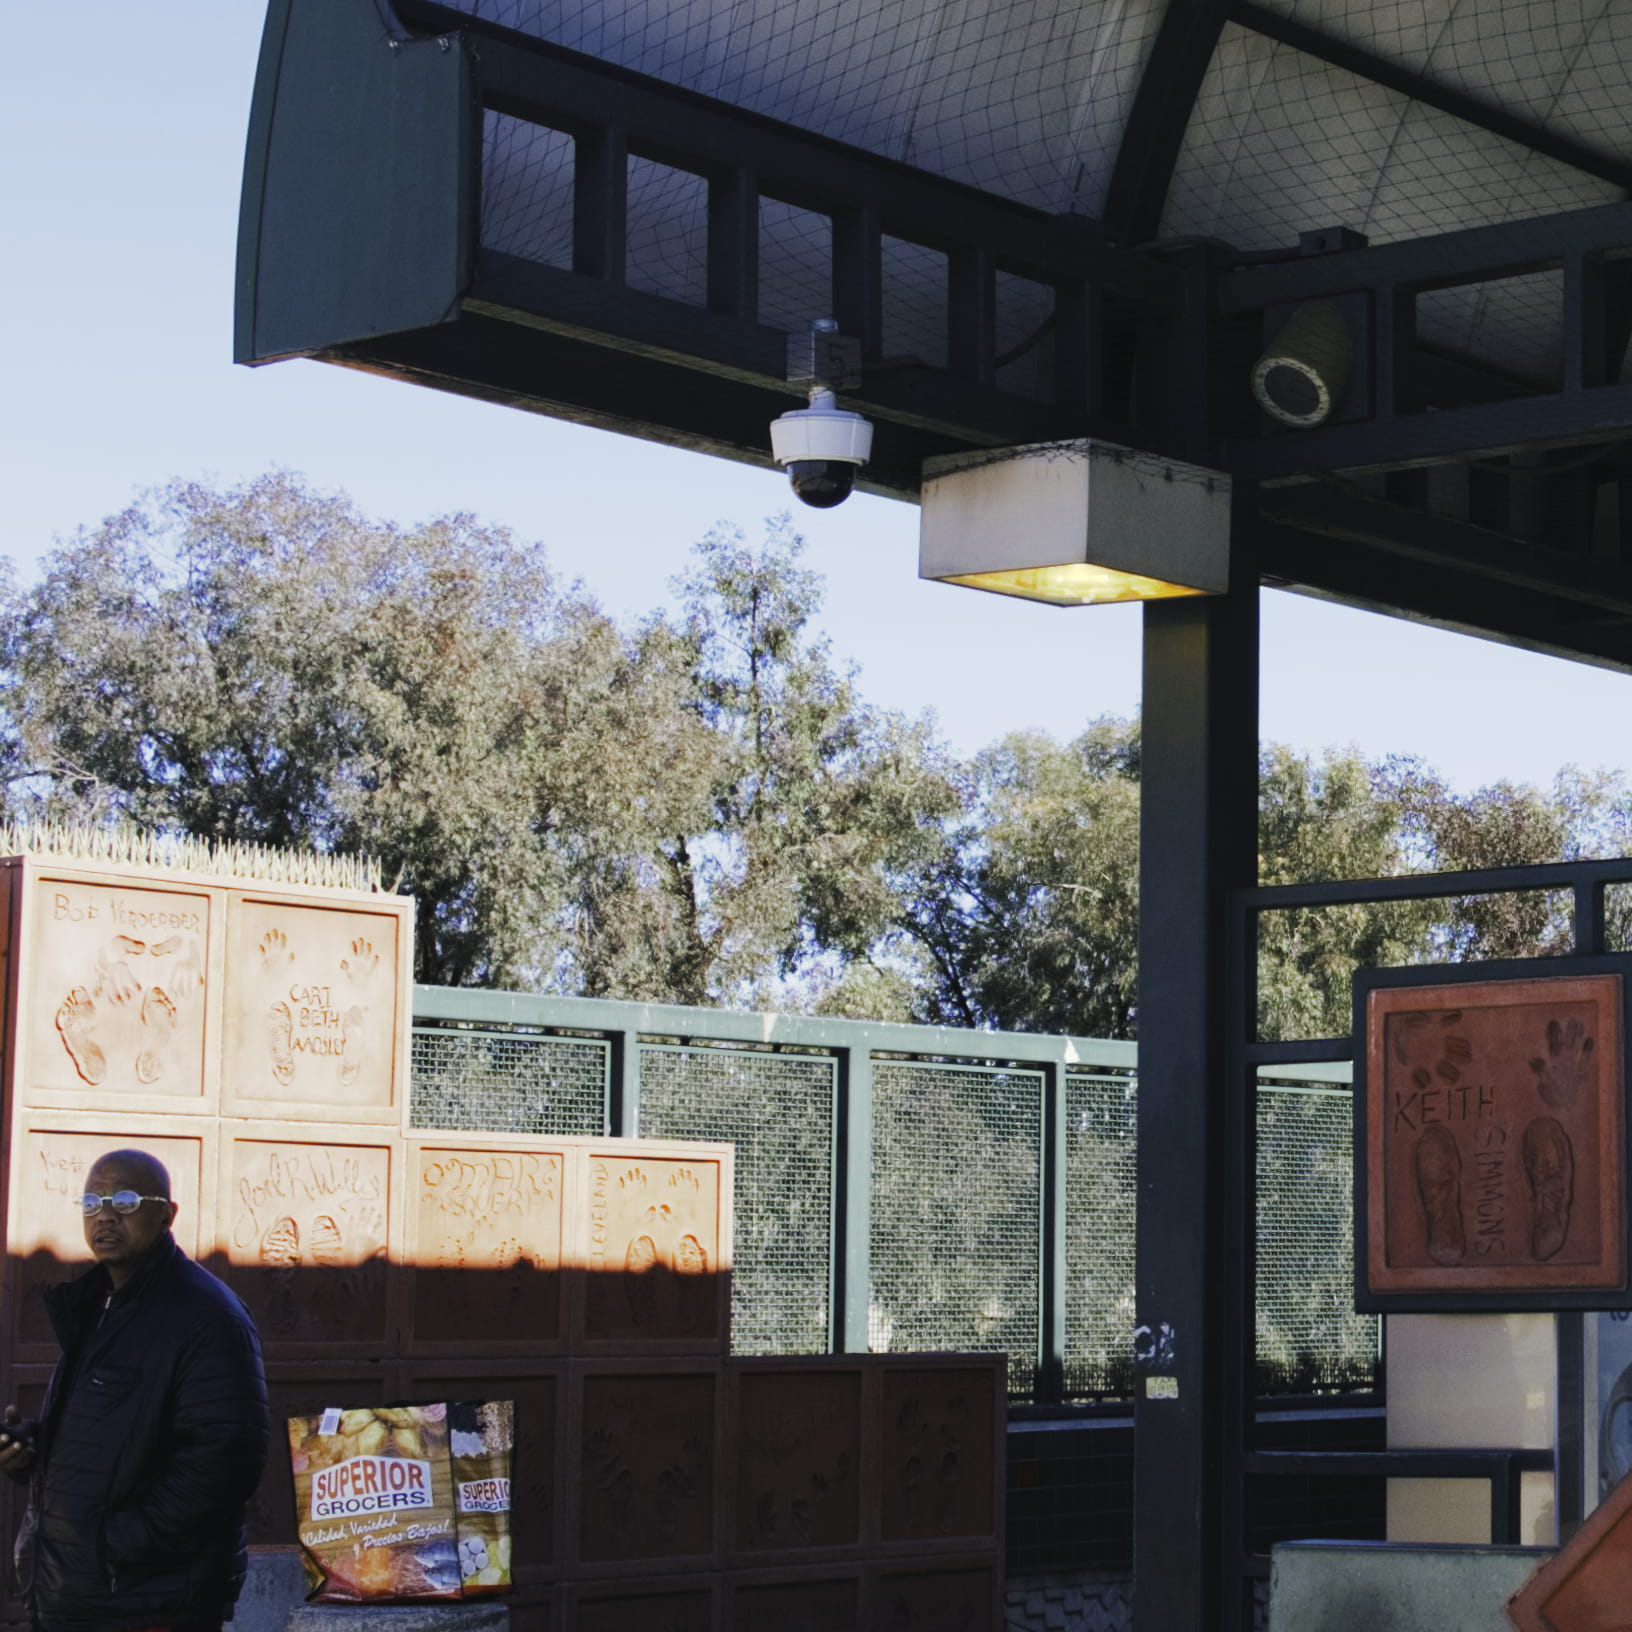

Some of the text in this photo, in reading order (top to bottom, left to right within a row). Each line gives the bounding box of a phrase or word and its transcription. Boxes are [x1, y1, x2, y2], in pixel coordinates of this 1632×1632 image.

[1394, 1085, 1496, 1133] KEITH
[316, 1459, 425, 1501] SUPERIOR
[316, 1491, 426, 1517] GROCERS
[464, 1500, 511, 1512] GROCE
